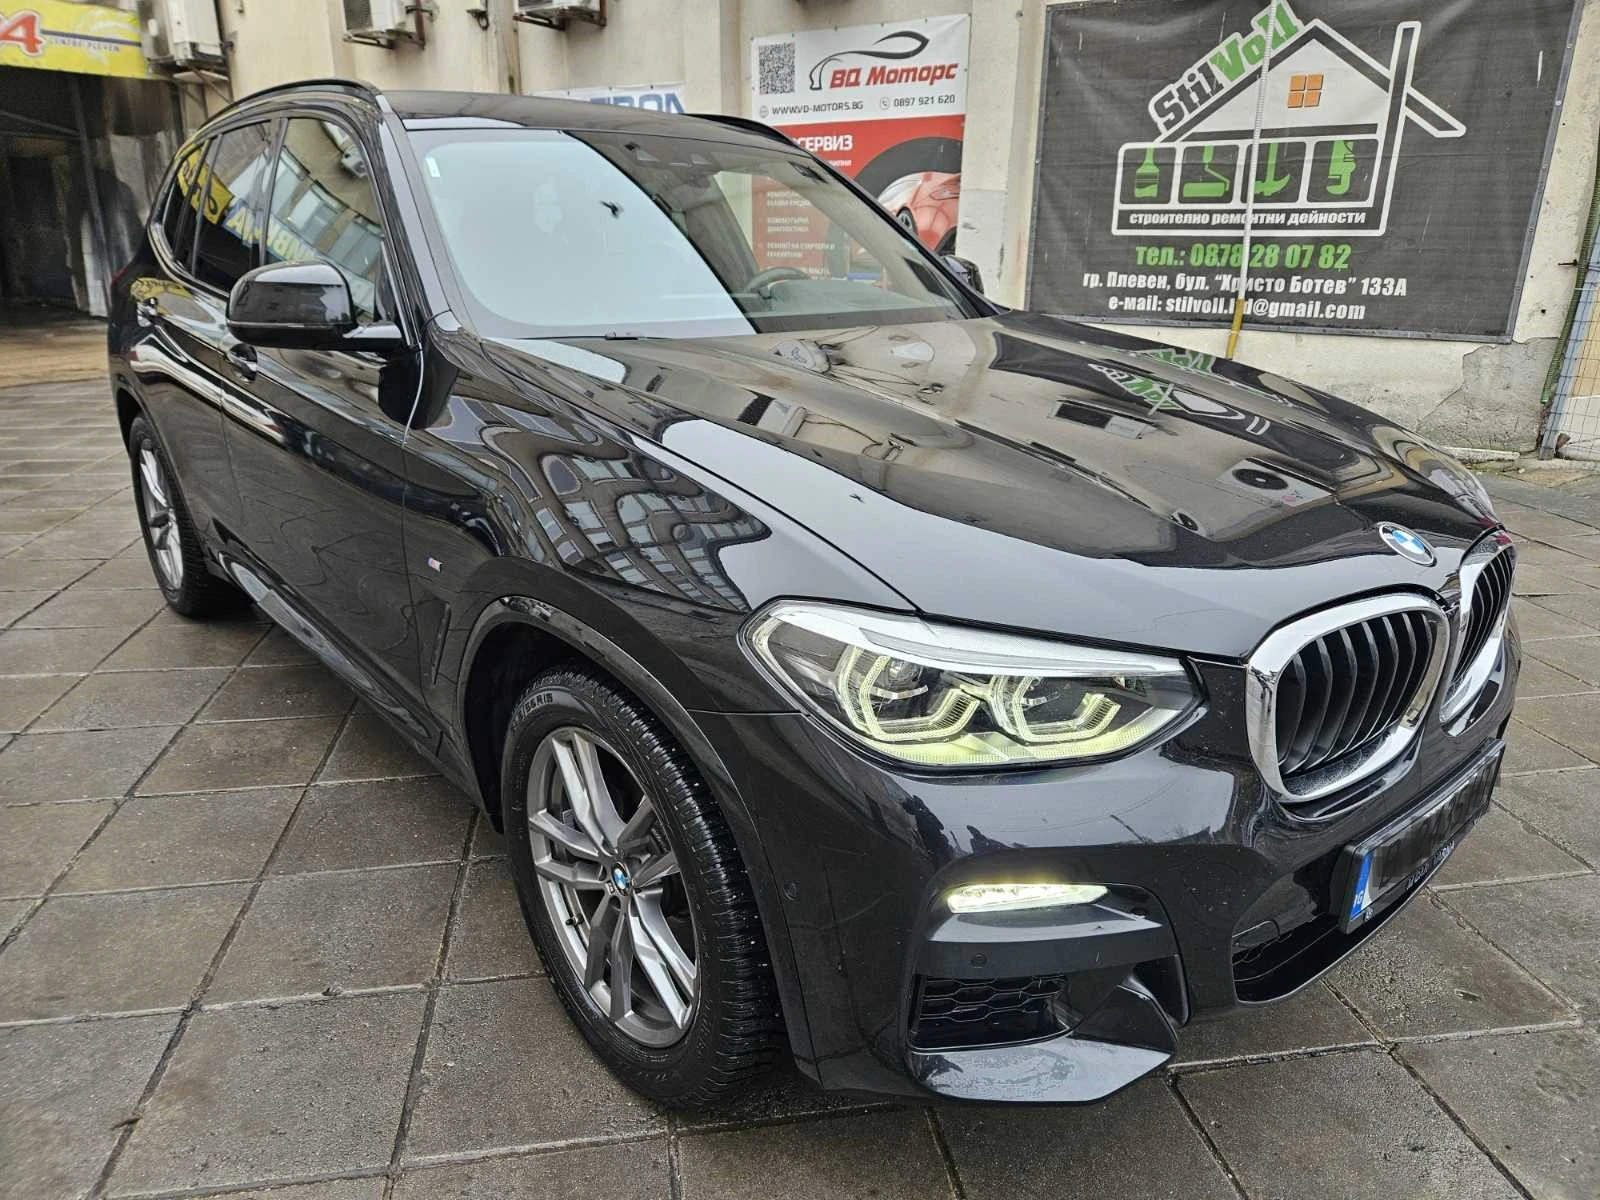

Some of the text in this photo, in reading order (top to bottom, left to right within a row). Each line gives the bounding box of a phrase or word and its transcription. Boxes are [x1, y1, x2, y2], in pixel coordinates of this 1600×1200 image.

[893, 94, 956, 107] 0897 921 620
[792, 135, 853, 152] СЕРВИЗ
[1286, 210, 1366, 226] дейности
[1189, 243, 1244, 268] 0878
[1249, 243, 1281, 268] 28
[1284, 243, 1314, 269] 07
[1318, 243, 1352, 269] 82
[1083, 272, 1103, 289] гр.
[1106, 271, 1171, 291] Плевен,
[1175, 273, 1210, 292] бул.
[1165, 295, 1366, 320] stilvoll.ld@gmail.com
